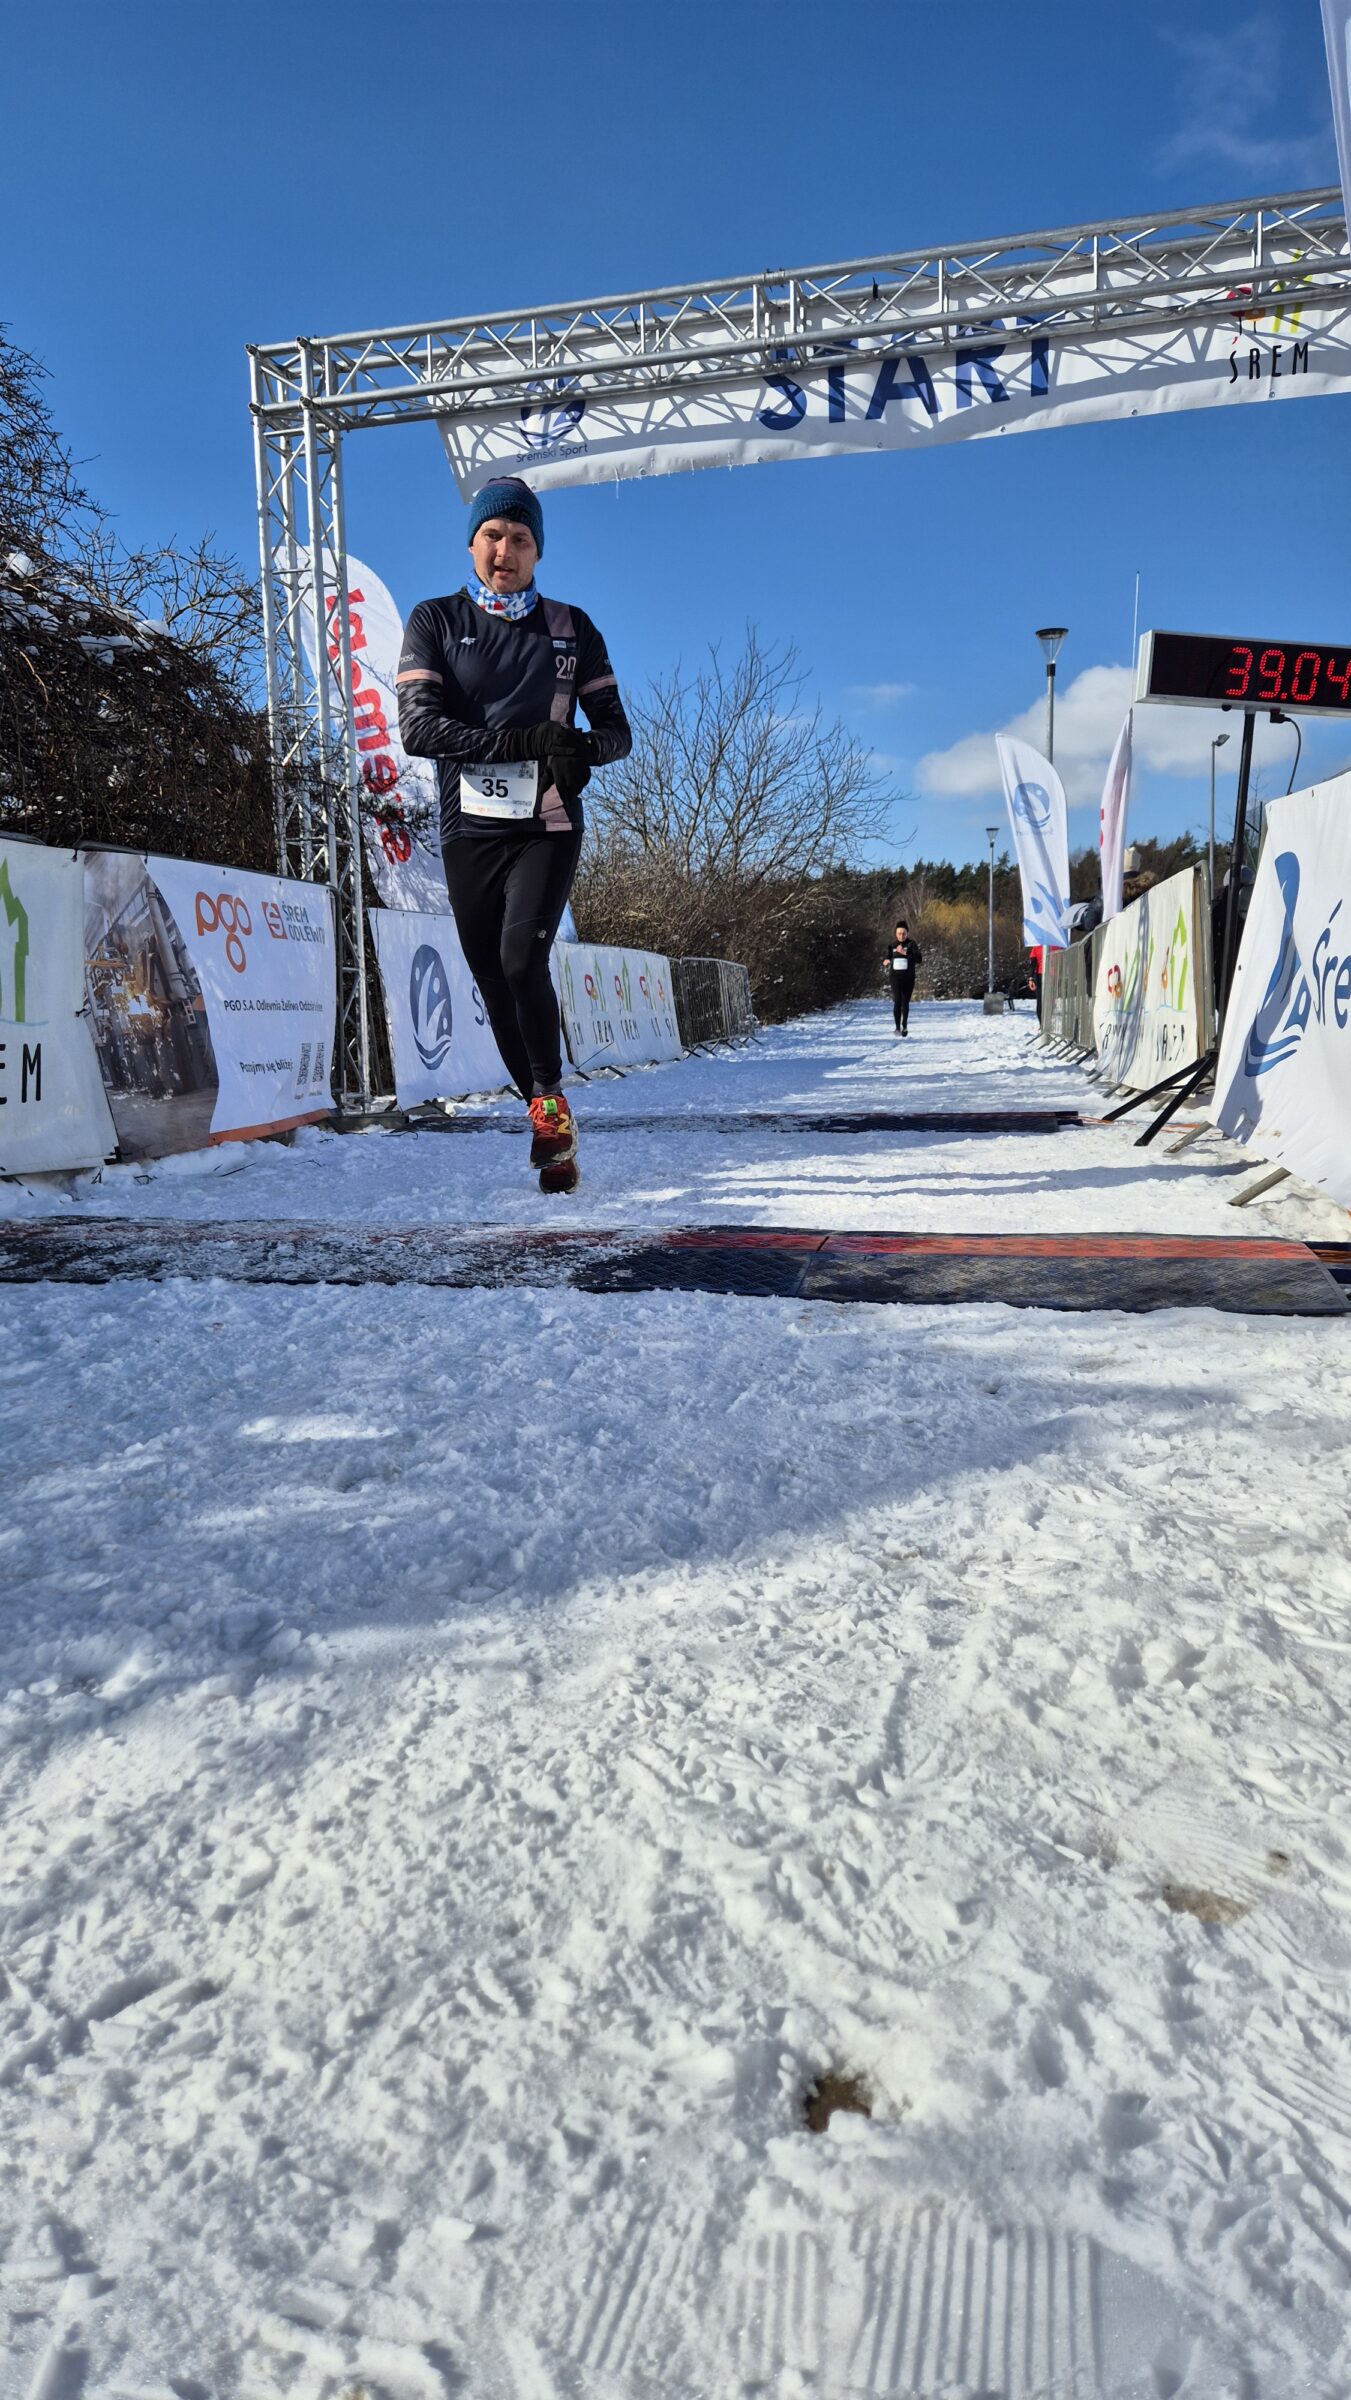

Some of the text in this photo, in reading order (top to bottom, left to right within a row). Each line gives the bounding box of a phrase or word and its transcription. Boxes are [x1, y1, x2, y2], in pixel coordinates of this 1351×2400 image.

[1229, 336, 1309, 384] ŚREM
[757, 310, 1066, 431] START
[516, 443, 588, 463] Śremski Sport
[481, 778, 509, 798] 35
[282, 900, 309, 923] ŚREM
[224, 999, 242, 1012] PGO
[242, 999, 256, 1011] S.A.
[265, 1060, 277, 1073] się
